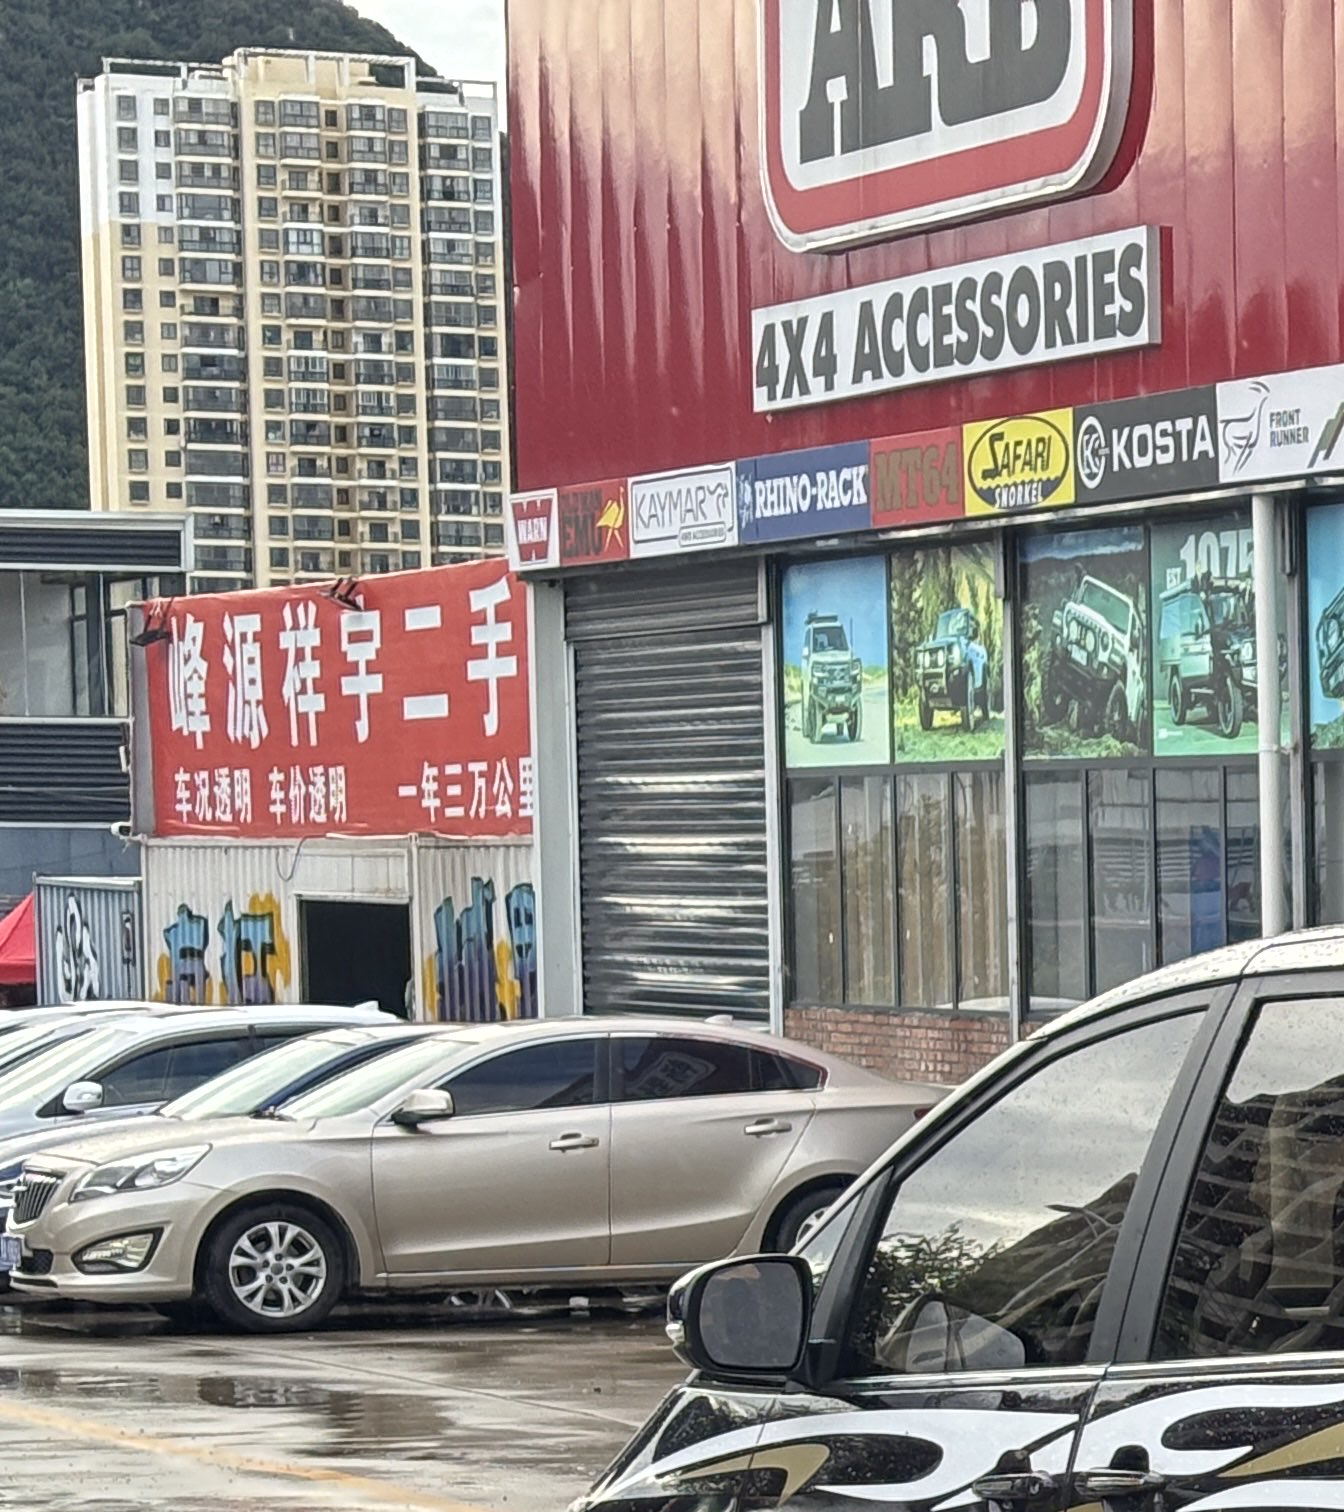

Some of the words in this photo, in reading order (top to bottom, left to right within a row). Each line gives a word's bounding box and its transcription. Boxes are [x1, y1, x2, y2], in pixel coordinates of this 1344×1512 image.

[756, 309, 837, 402] 4X4
[851, 242, 1144, 384] ACCESSORIES
[1269, 409, 1301, 428] FRONT
[1270, 426, 1309, 447] RUNNER
[981, 432, 1052, 480] SAFARI
[1112, 415, 1215, 472] KOSTA
[755, 465, 868, 518] RHINO-RACK
[875, 441, 958, 512] MT64
[994, 483, 1043, 509] SNORKEL
[517, 516, 548, 545] WARN
[635, 486, 707, 529] KAYMAR
[174, 766, 252, 824] 车况透明
[269, 764, 347, 825] 车价透明
